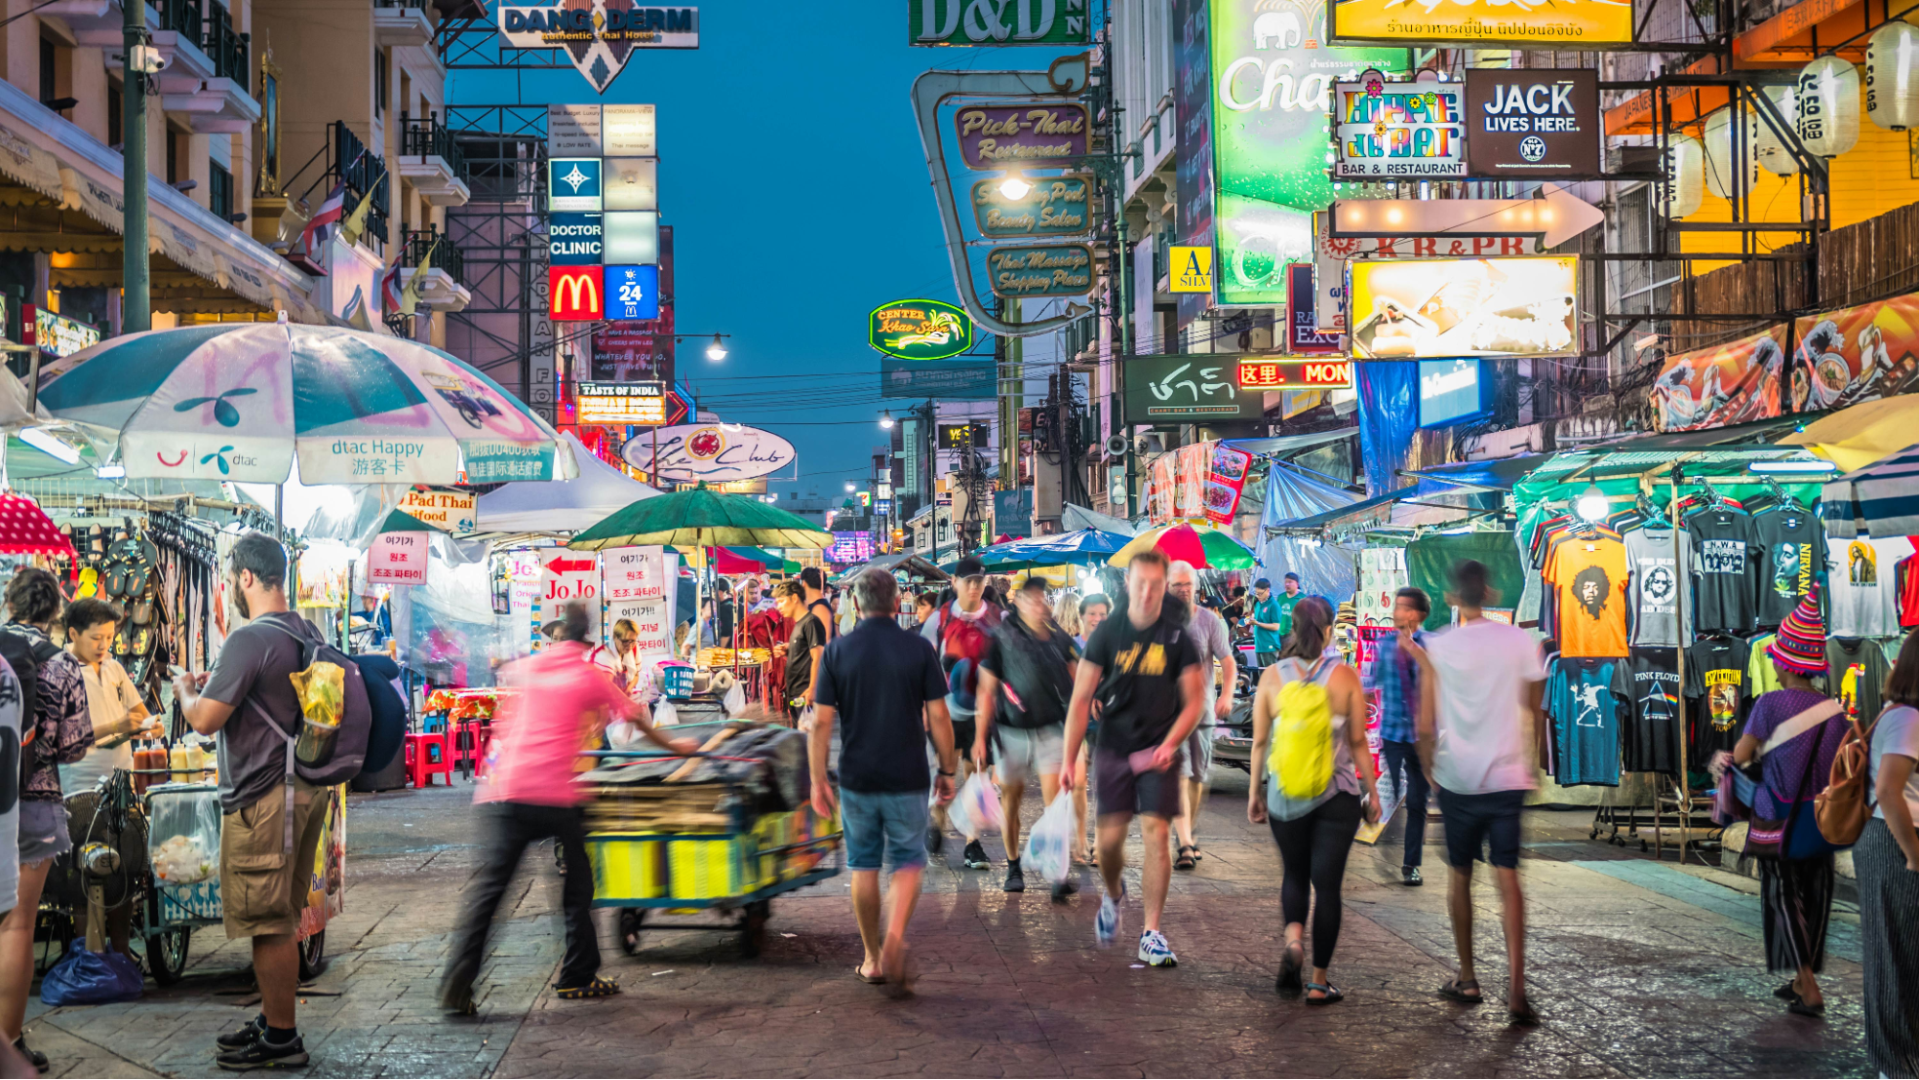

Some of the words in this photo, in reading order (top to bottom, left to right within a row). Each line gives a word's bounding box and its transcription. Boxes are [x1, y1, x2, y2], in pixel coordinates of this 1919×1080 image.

[504, 9, 592, 31] DANG
[606, 9, 691, 31] DERM
[917, 0, 1055, 41] D&D
[1387, 18, 1492, 37] ร้านอาหารญี่ปุ่น
[541, 32, 592, 40] Authentic
[599, 32, 620, 40] Thai
[625, 31, 655, 40] Hotel
[1484, 84, 1575, 114] JACK
[962, 110, 1083, 136] Pick-Thai
[1485, 117, 1529, 131] LIVES
[1534, 117, 1580, 131] HERE.
[978, 138, 1072, 160] Restaurant
[1342, 164, 1366, 174] BAR
[1372, 164, 1381, 174] &
[1387, 164, 1463, 174] RESTAURANT
[1051, 182, 1085, 202] Pool
[987, 208, 1036, 232] Beauty
[1039, 207, 1081, 227] Salon
[550, 225, 601, 235] DOCTOR
[550, 242, 601, 254] CLINIC
[991, 254, 1025, 270] Thai
[1027, 251, 1088, 270] Massage
[998, 272, 1051, 292] Shopping
[1052, 269, 1088, 287] Plaza
[1180, 277, 1211, 286] SILV
[619, 286, 642, 301] 24
[877, 309, 926, 320] CENTER
[877, 319, 916, 333] Khao
[535, 368, 549, 421] FOO
[582, 387, 614, 395] TASTE
[616, 387, 627, 395] OF
[631, 387, 659, 395] INDIA
[332, 440, 368, 455] dtac
[372, 440, 424, 458] Happy
[715, 444, 784, 464] Club
[232, 454, 257, 466] dtac
[352, 458, 406, 476] 游客卡
[408, 493, 435, 506] Pad
[439, 496, 473, 509] Thai
[390, 553, 408, 562] 원조
[620, 554, 648, 564] 여기가
[373, 568, 392, 577] 조조
[394, 569, 422, 579] 파타이
[626, 571, 645, 580] 원조
[1798, 543, 1812, 596] NIRVANA
[613, 588, 631, 597] 조조
[633, 586, 661, 597] 파타이
[622, 606, 655, 617] 여기가!!
[1634, 672, 1653, 681] PINK
[1655, 672, 1680, 682] FLOYD
